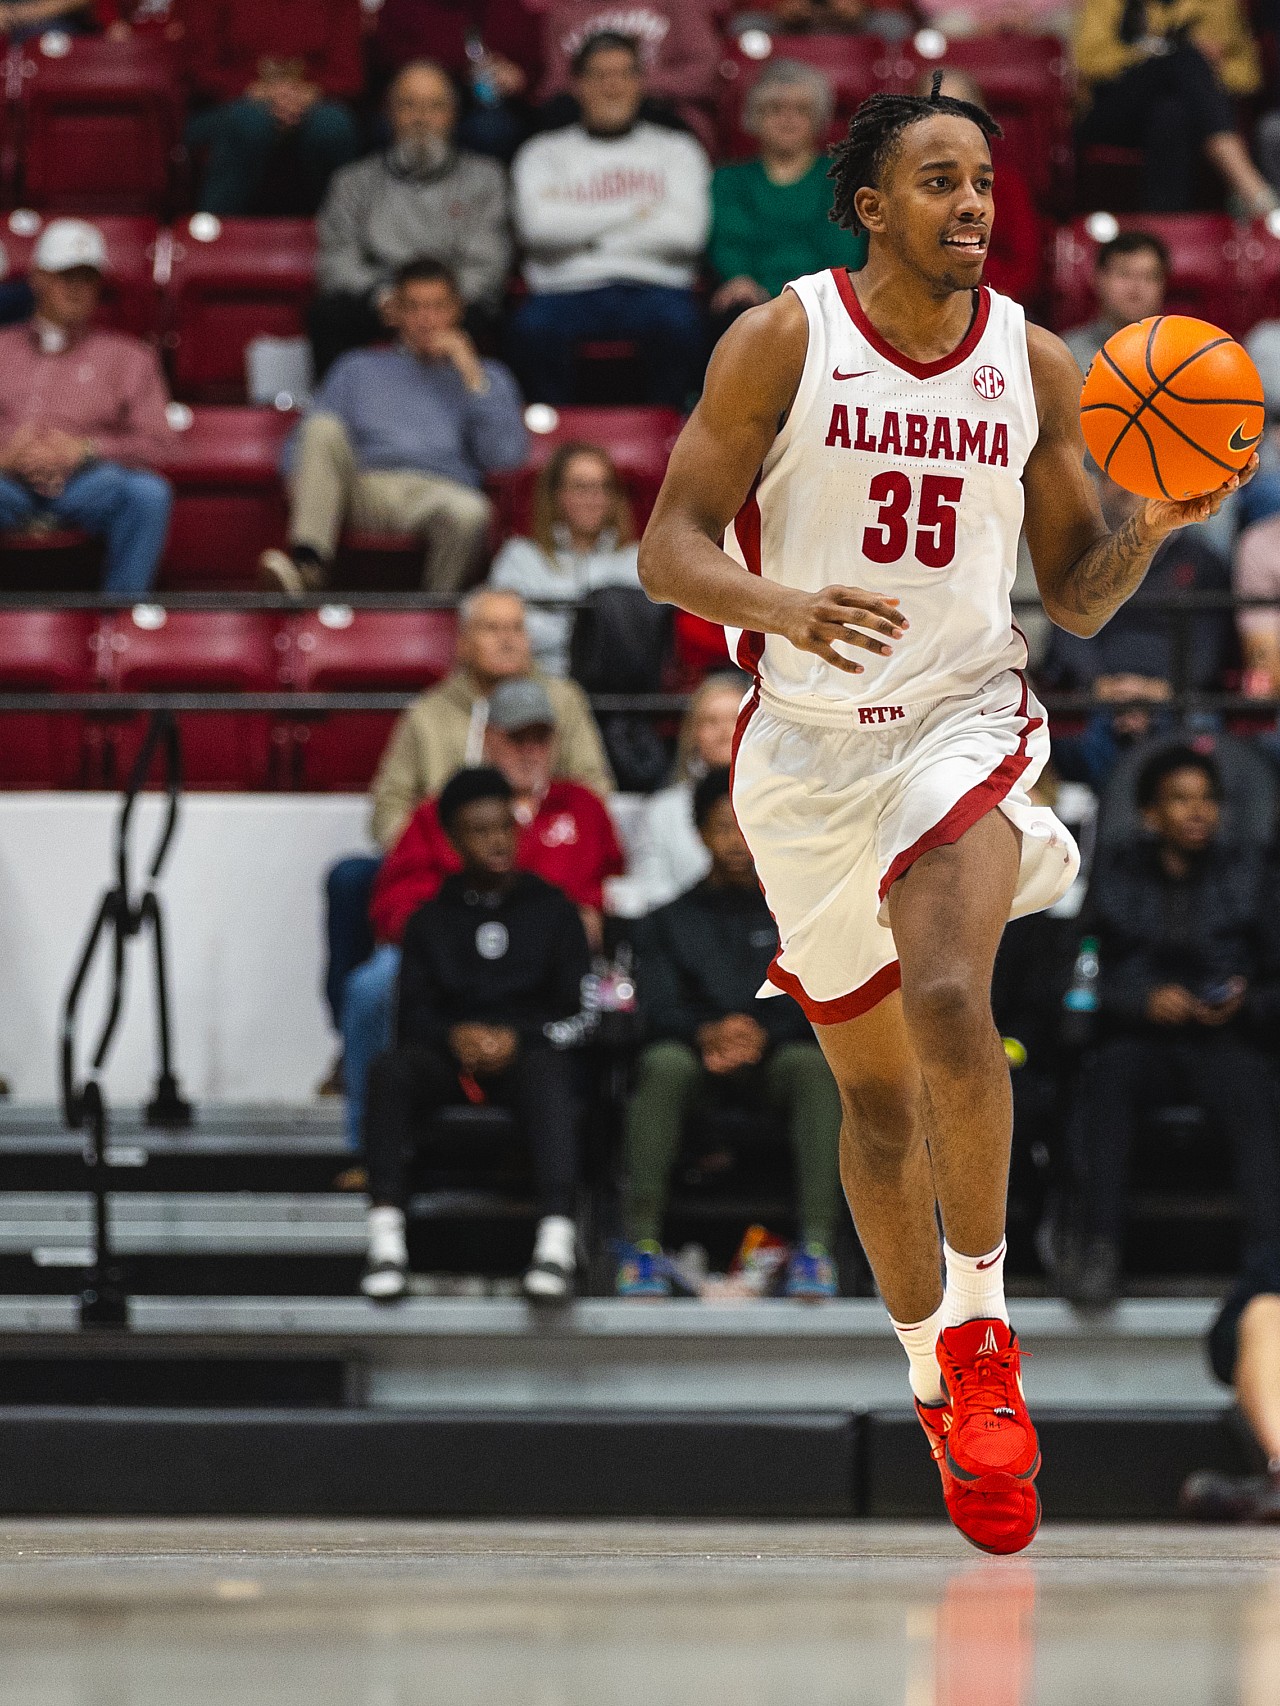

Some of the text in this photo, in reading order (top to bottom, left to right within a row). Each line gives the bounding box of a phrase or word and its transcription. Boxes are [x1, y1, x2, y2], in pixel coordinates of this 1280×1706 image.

[974, 366, 1004, 399] SEC
[825, 403, 1009, 467] ALABAMA
[861, 470, 965, 568] 35
